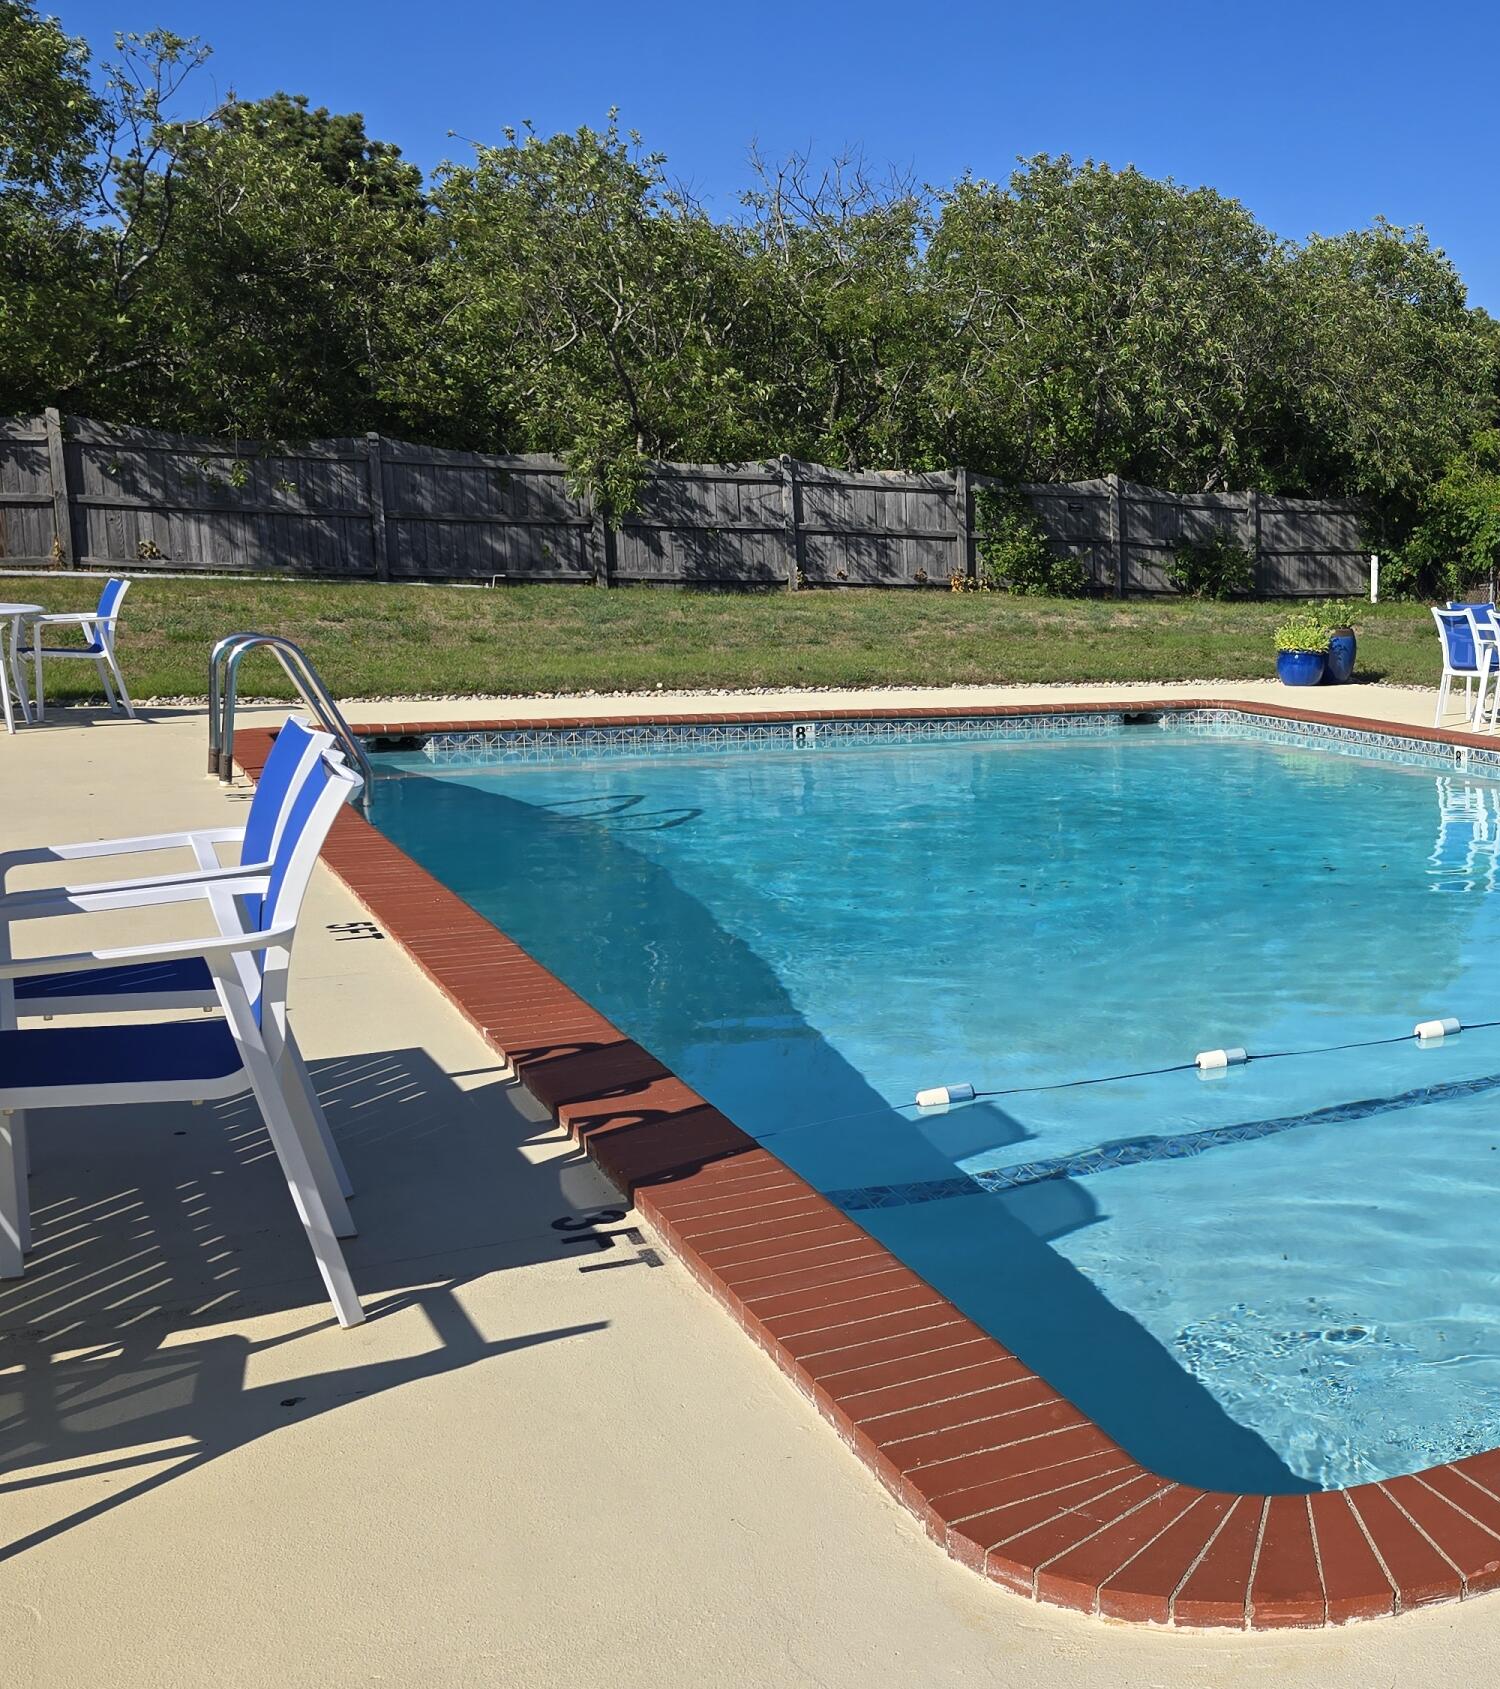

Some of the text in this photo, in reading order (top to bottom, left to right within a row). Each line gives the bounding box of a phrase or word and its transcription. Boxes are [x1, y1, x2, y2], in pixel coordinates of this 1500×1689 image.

[796, 726, 806, 741] 8
[325, 922, 385, 941] 5FT
[551, 1209, 665, 1274] 3FT
